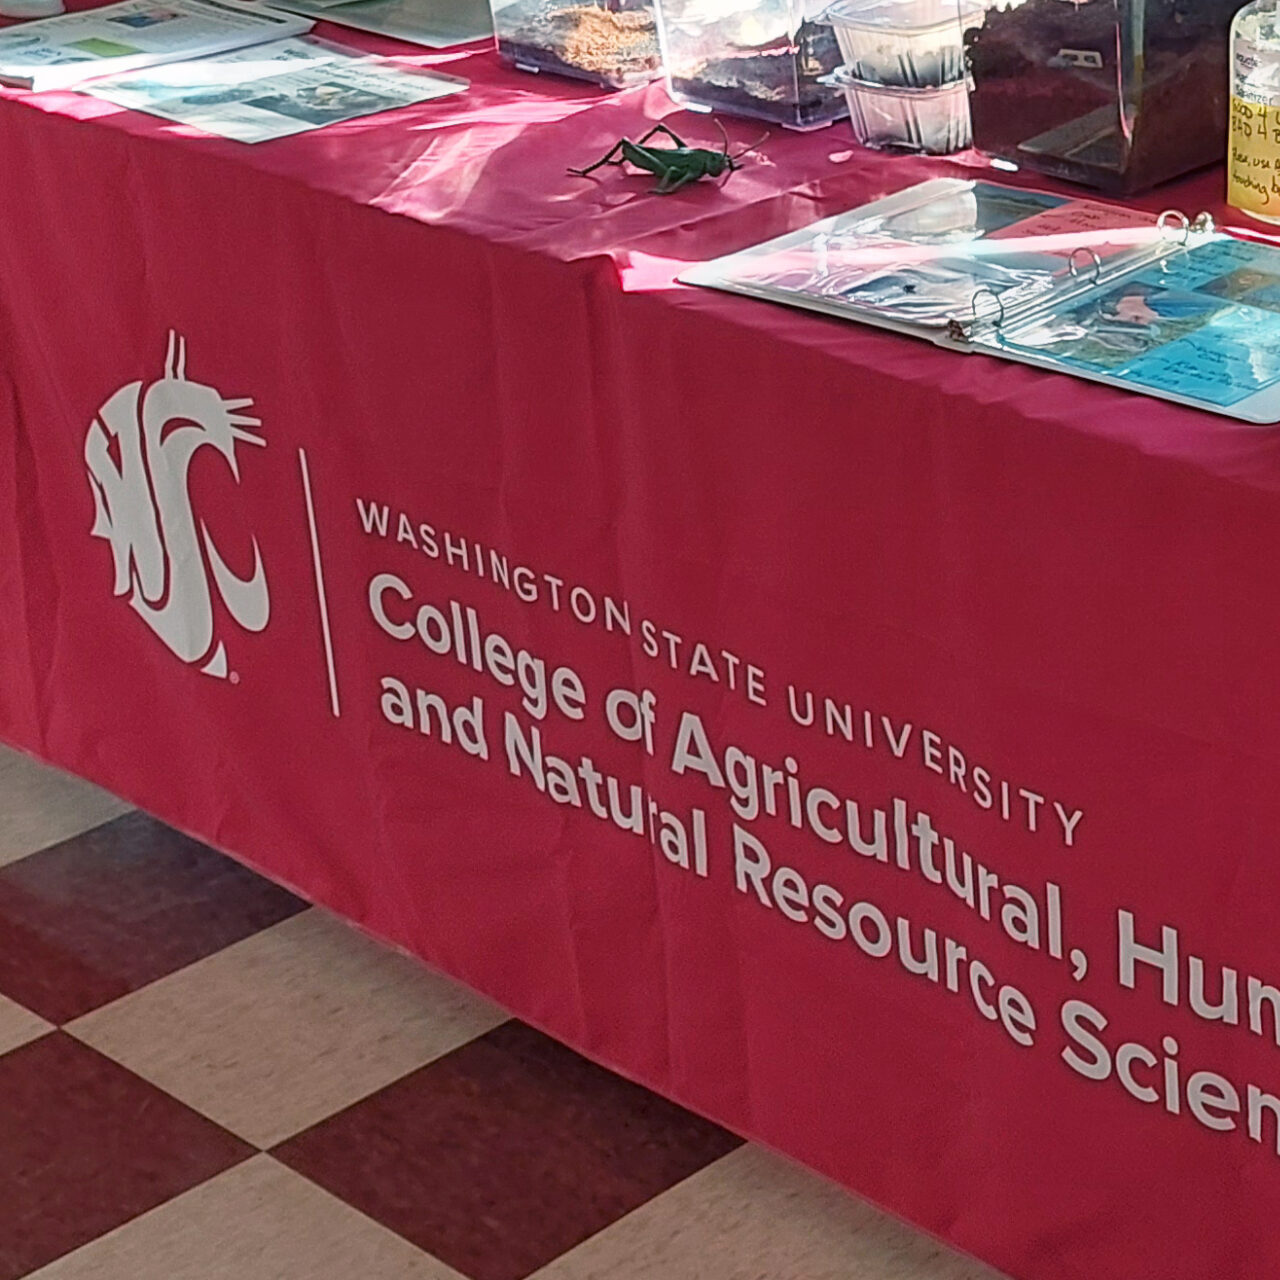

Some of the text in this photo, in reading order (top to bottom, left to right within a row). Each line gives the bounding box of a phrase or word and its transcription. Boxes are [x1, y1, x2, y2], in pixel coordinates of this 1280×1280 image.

[356, 498, 1083, 846] WASHINGTON STATE UNIVERSITY
[369, 573, 586, 720] College
[606, 689, 657, 755] of
[671, 712, 1087, 981] Agricultural,
[381, 677, 488, 760] and
[505, 711, 708, 877] Natural
[733, 823, 1036, 1046] Resource
